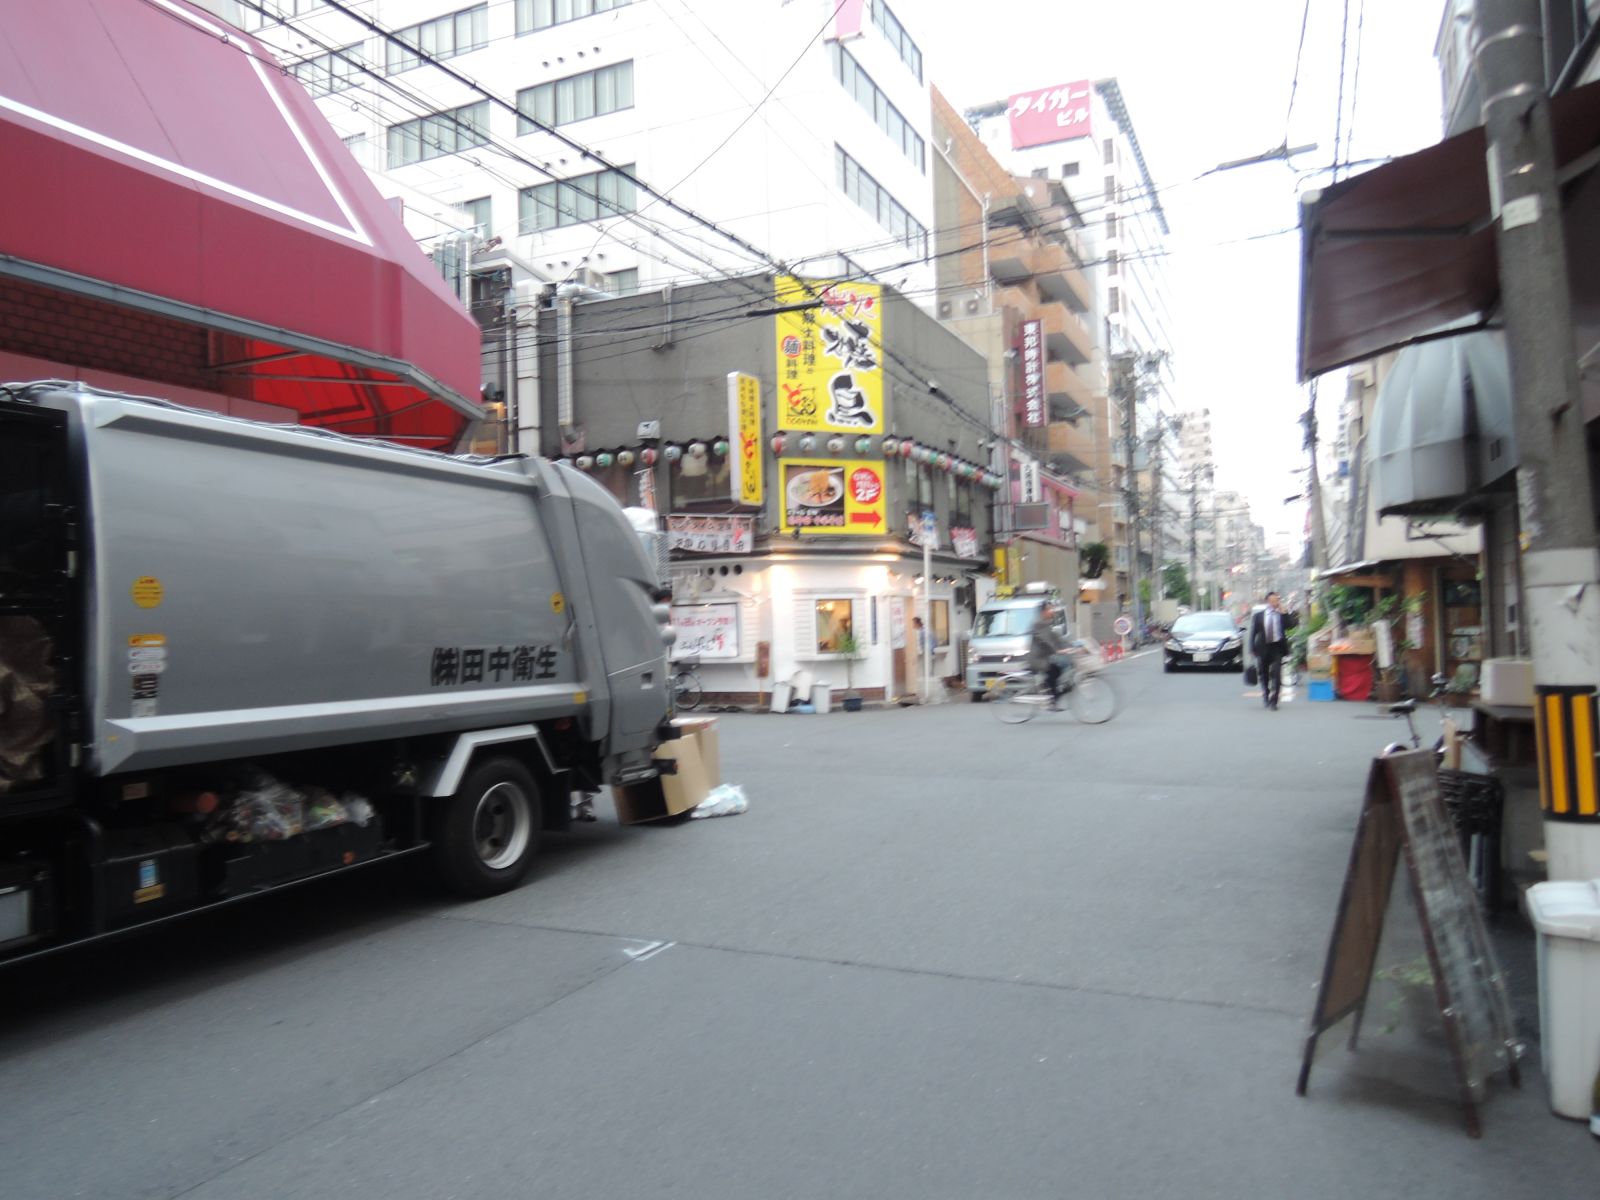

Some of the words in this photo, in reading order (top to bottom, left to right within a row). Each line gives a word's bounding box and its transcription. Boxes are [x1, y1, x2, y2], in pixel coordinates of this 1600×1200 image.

[1010, 87, 1089, 117] タイガー
[1057, 107, 1089, 127] ビル
[856, 489, 880, 502] 2F
